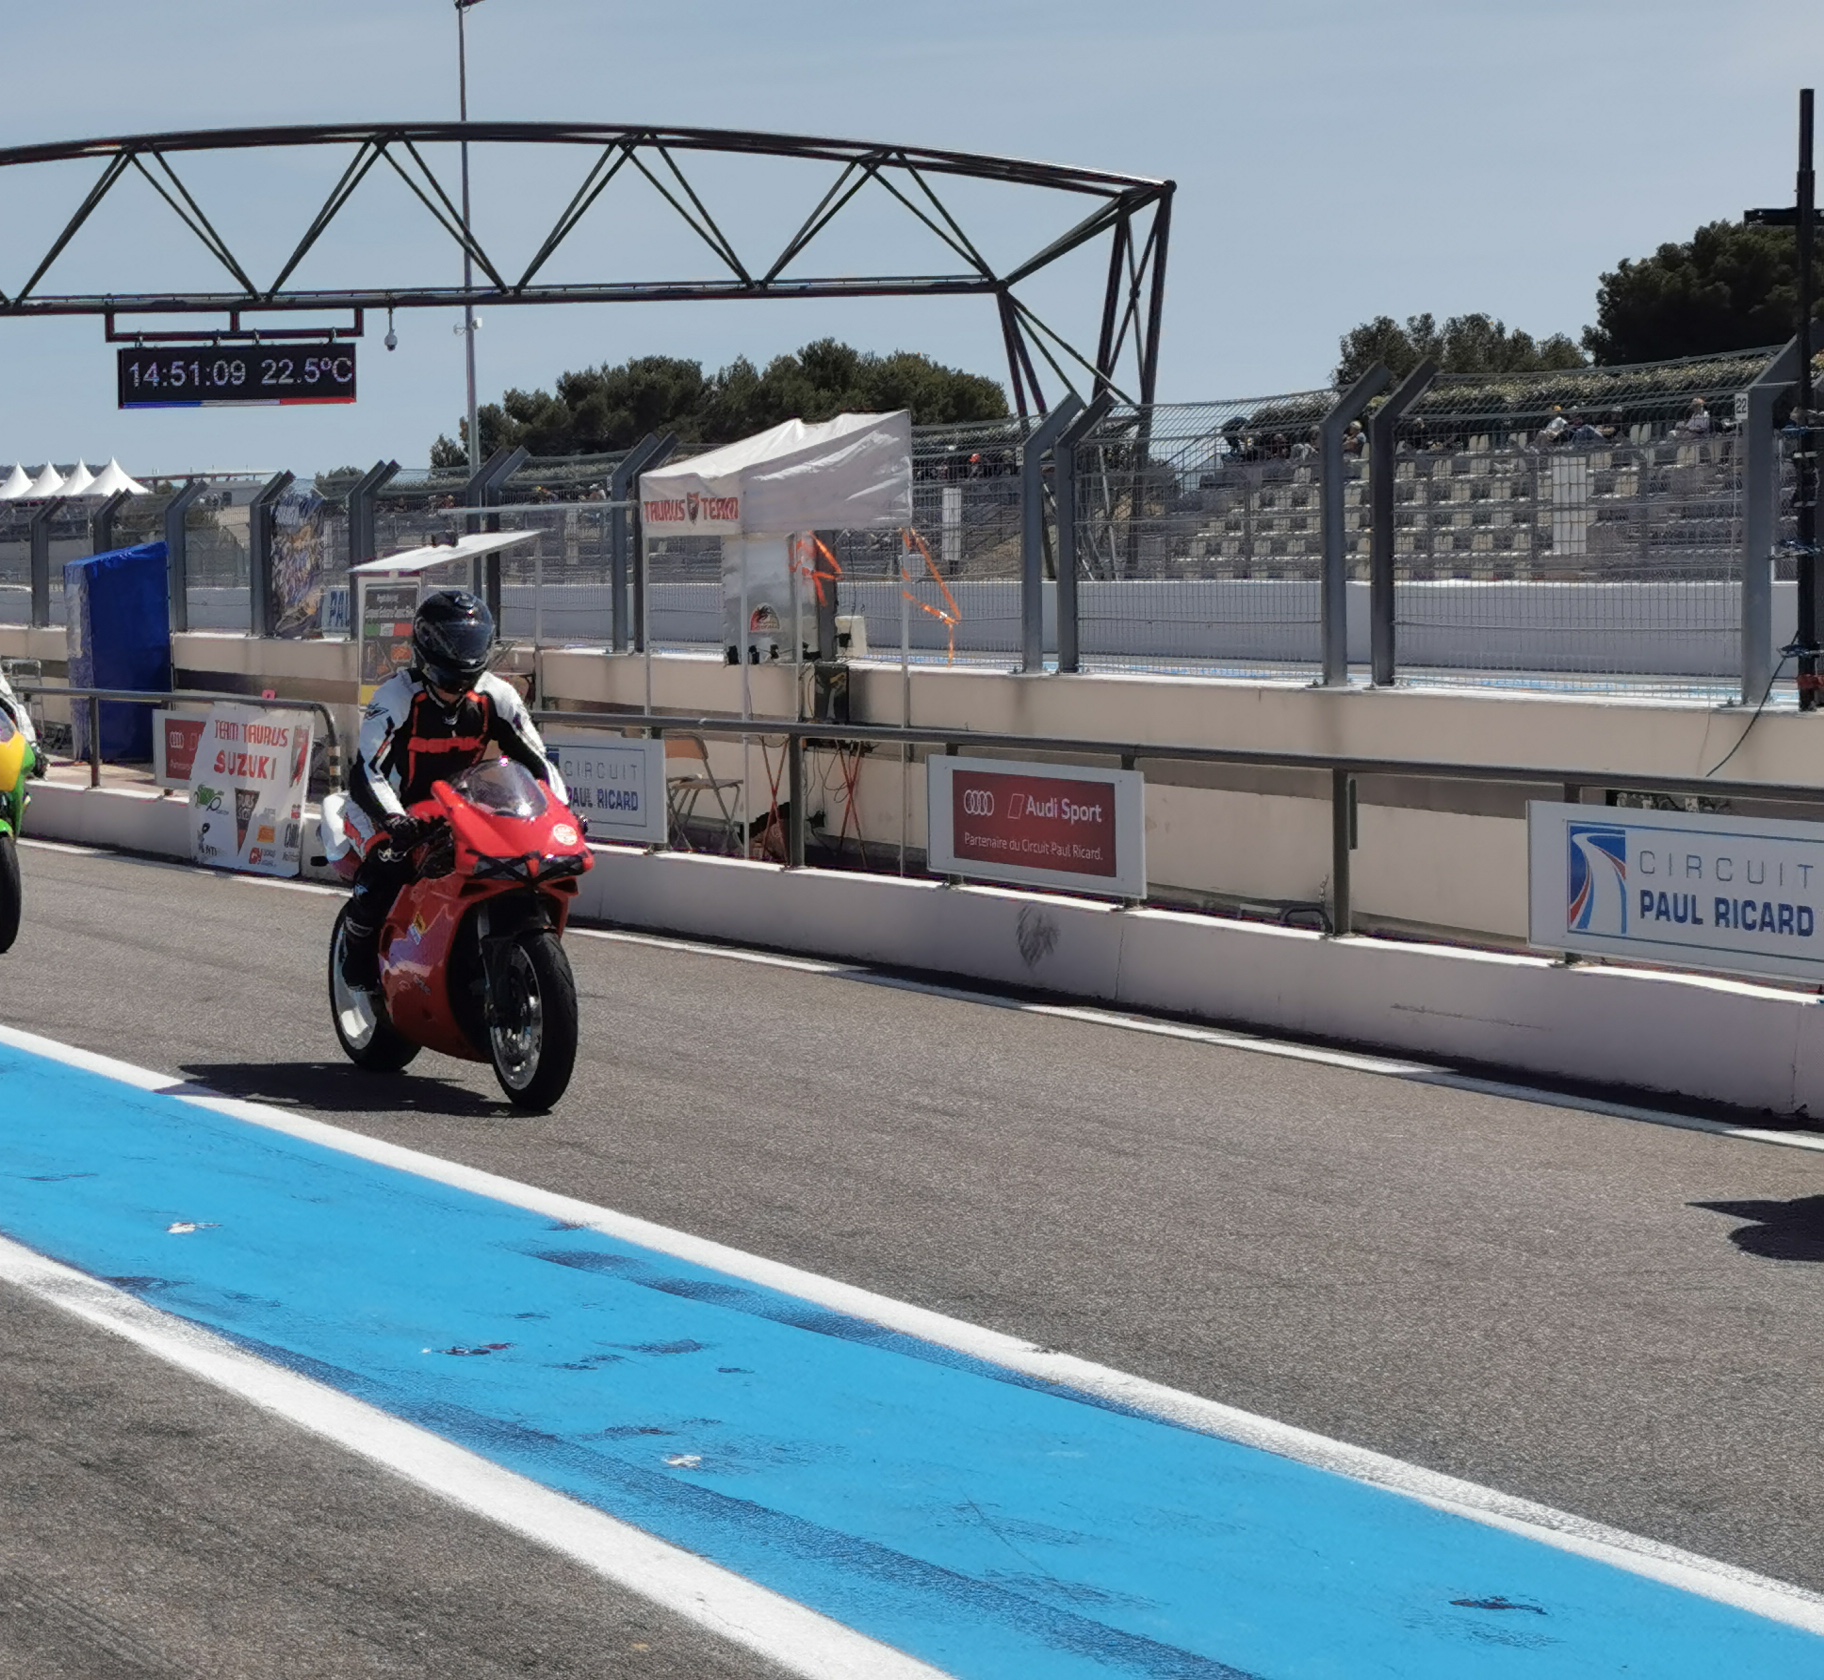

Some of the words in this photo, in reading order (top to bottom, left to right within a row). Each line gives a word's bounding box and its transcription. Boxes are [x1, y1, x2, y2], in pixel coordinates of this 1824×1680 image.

[129, 359, 246, 387] 14:51:09
[700, 496, 739, 520] TEAM
[214, 720, 239, 741] TEAM
[241, 723, 290, 748] TAURUS
[213, 749, 277, 781] SUZUKI
[563, 760, 638, 781] CIRCUIT
[597, 788, 639, 811] RICARD
[1026, 794, 1058, 818] Audi
[1061, 798, 1102, 825] Sport
[964, 831, 1007, 850] Partenaire
[1009, 839, 1021, 851] du
[1022, 839, 1050, 855] Circuit
[1051, 841, 1071, 857] Paul
[1639, 850, 1814, 889] CIRCUIT
[1639, 889, 1704, 926] PAUL
[1714, 896, 1814, 937] RICARD
